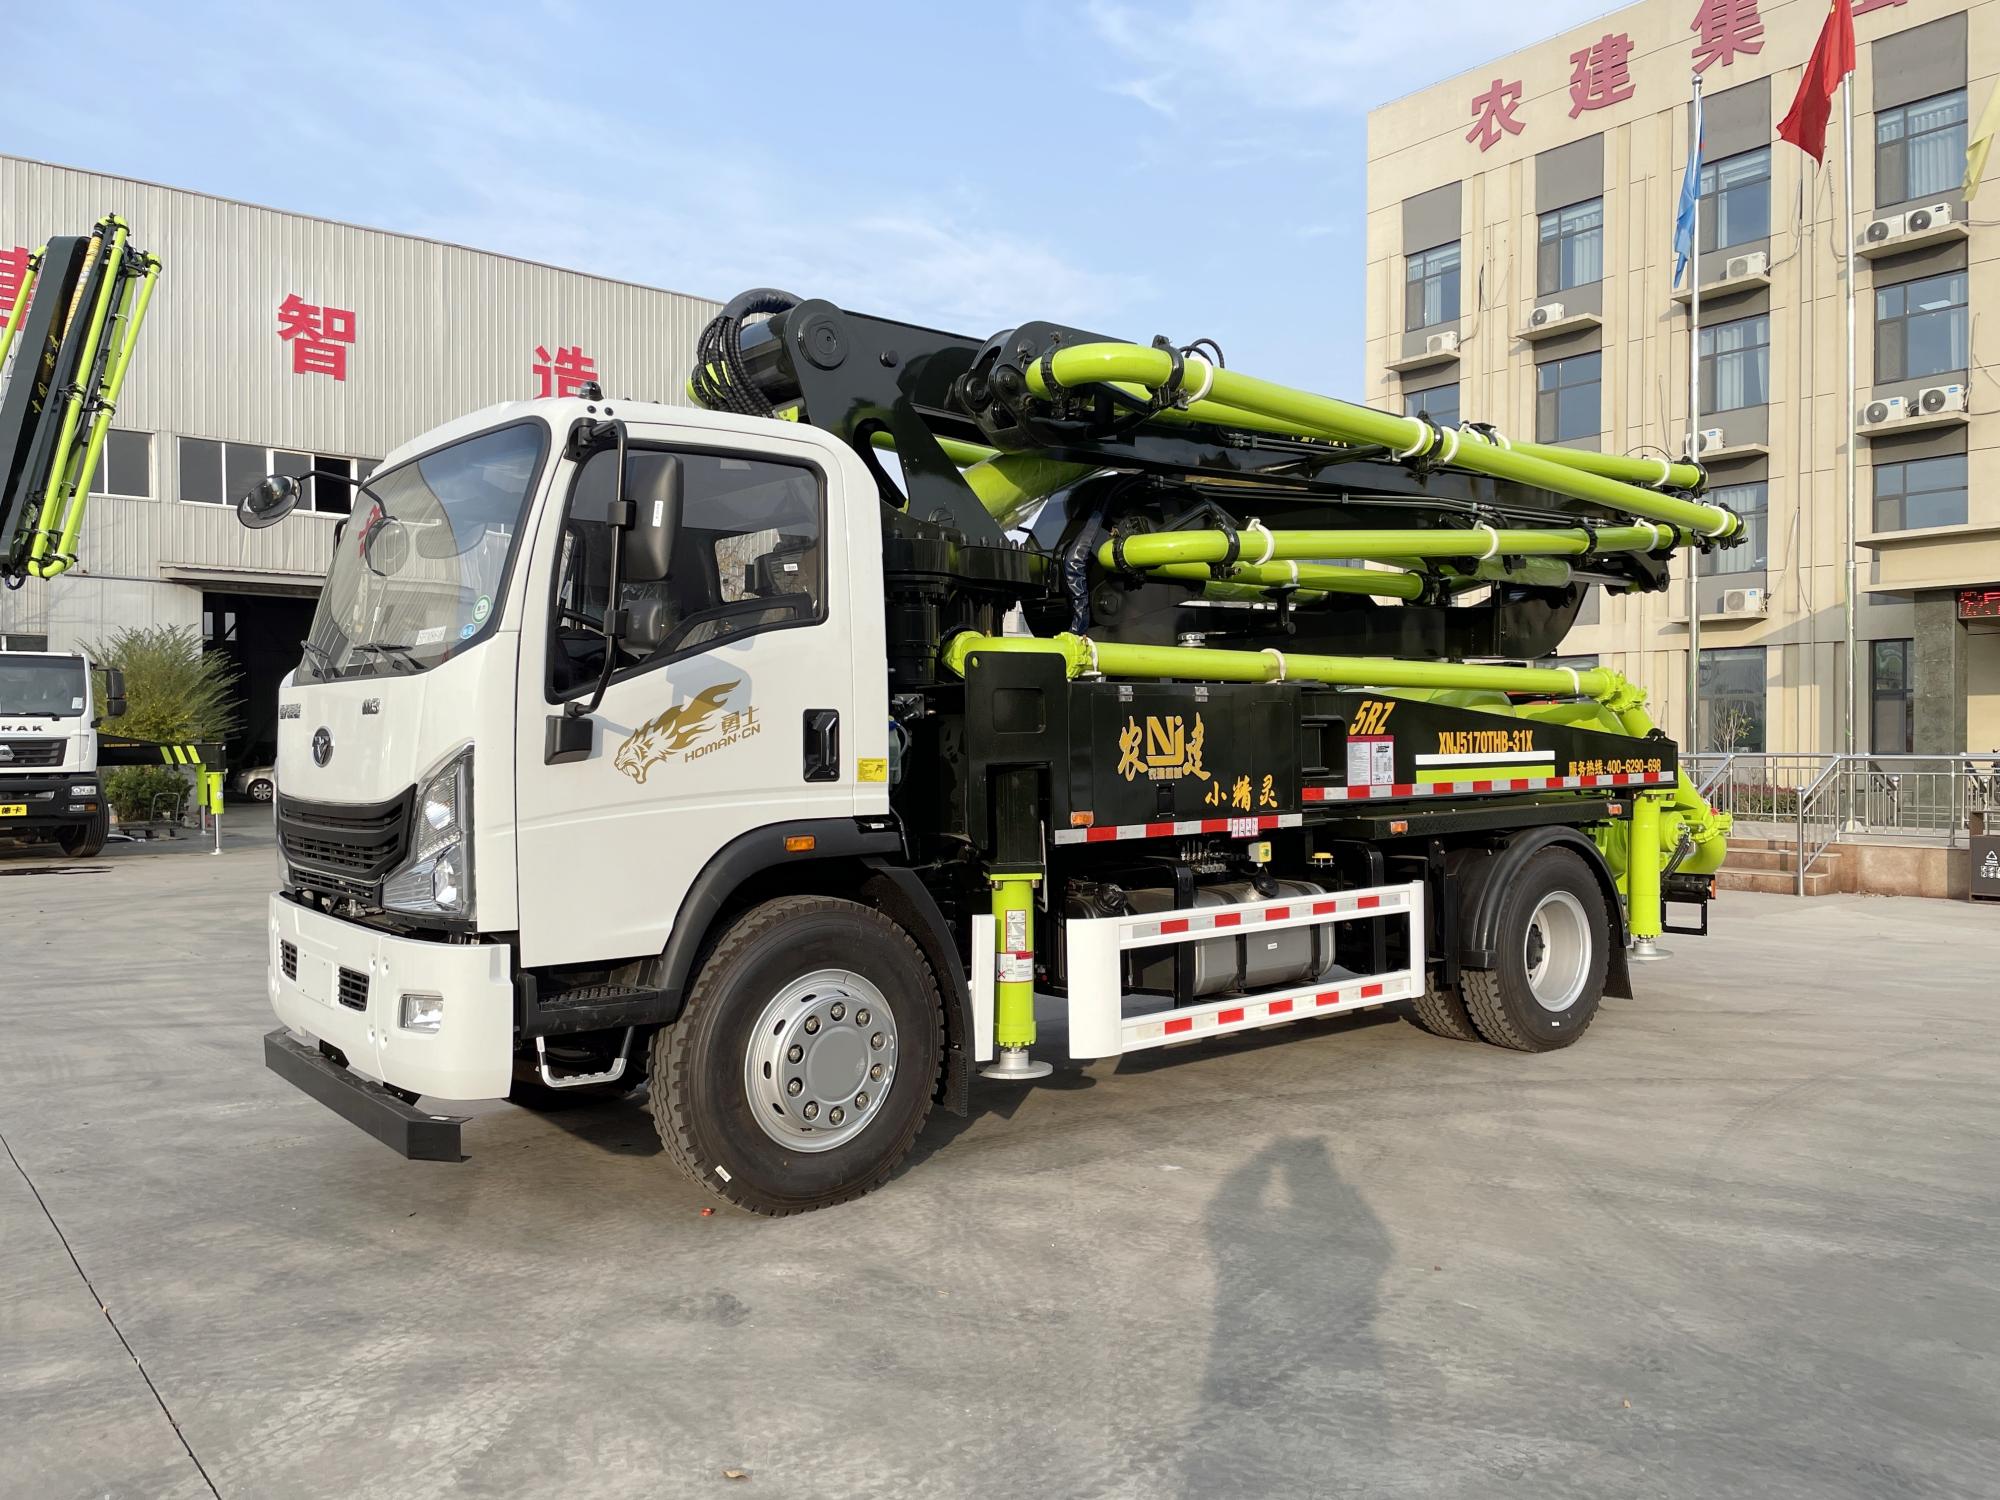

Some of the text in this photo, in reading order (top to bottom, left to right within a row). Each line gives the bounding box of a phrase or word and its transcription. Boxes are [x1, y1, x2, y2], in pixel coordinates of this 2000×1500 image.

[721, 705, 760, 736] 勇士
[1349, 700, 1396, 736] 5RZ
[1438, 729, 1534, 755] XNJ5170THB-31X
[1204, 774, 1278, 812] 小精灵
